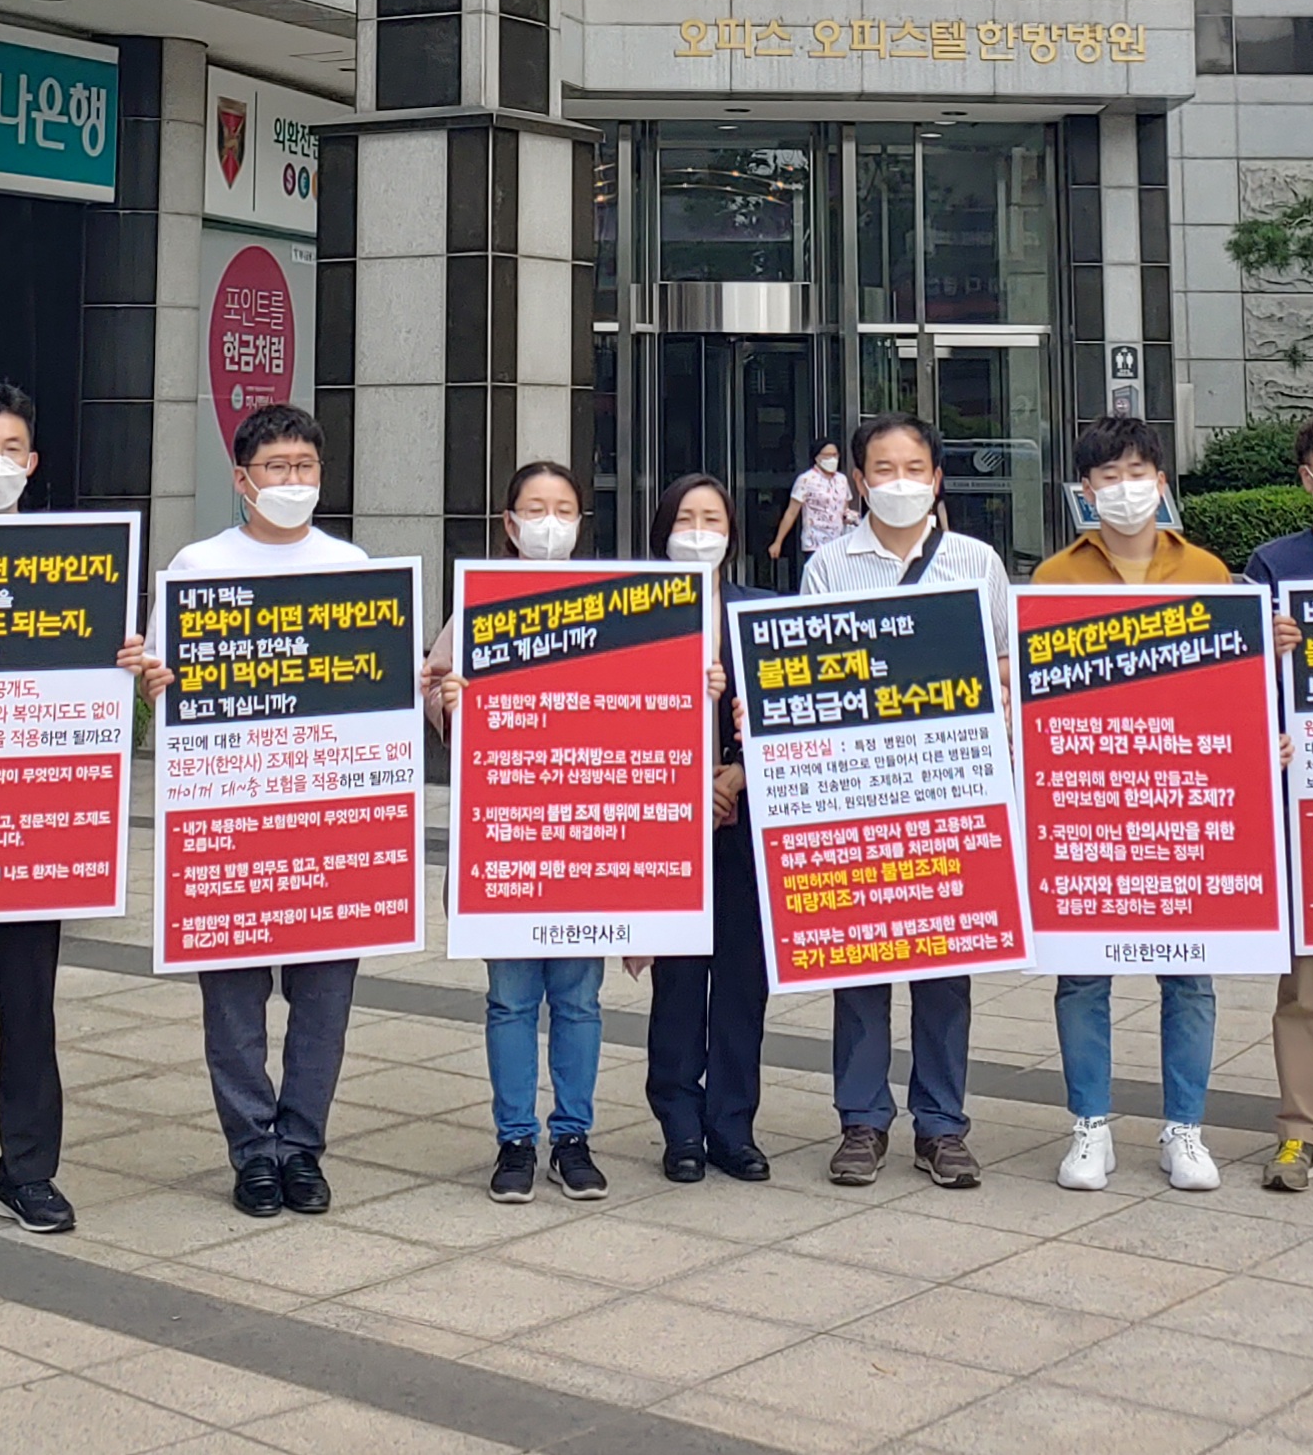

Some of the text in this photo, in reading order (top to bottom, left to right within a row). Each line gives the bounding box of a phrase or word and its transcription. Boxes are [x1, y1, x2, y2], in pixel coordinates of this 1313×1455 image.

[674, 18, 1146, 63] 오피스 오피스텔 한방병원
[223, 288, 285, 330] 포인트를
[223, 331, 284, 373] 현금처럼
[13, 554, 119, 583] 처방인지,
[179, 586, 254, 609] 내가 먹는
[472, 575, 697, 644] 첩약 건강보험 시범사업,
[11, 609, 93, 639] 되는지,
[179, 599, 405, 638] 한약이 어떤 처방인지,
[752, 611, 915, 651] 비면허자에 의한
[1027, 602, 1211, 665] 첩약(한약)보험은
[179, 636, 309, 663] 다른 약과 한약을
[472, 627, 597, 671] 알고 계십니까?
[1028, 630, 1248, 695] 한약사가 당사자입니다.
[179, 652, 383, 693] 같이 먹어도 되는지,
[757, 649, 889, 690] 불법 조제는
[179, 693, 297, 720] 알고 계십니까?
[762, 677, 982, 727] 보험급여 환수대상
[1126, 821, 1235, 841] 한의사만을 위한
[532, 924, 631, 945] 대한한약사회
[792, 931, 1014, 969] 국가 보험재정을 지급하겠다는 것
[1105, 943, 1205, 962] 대한한약사회
